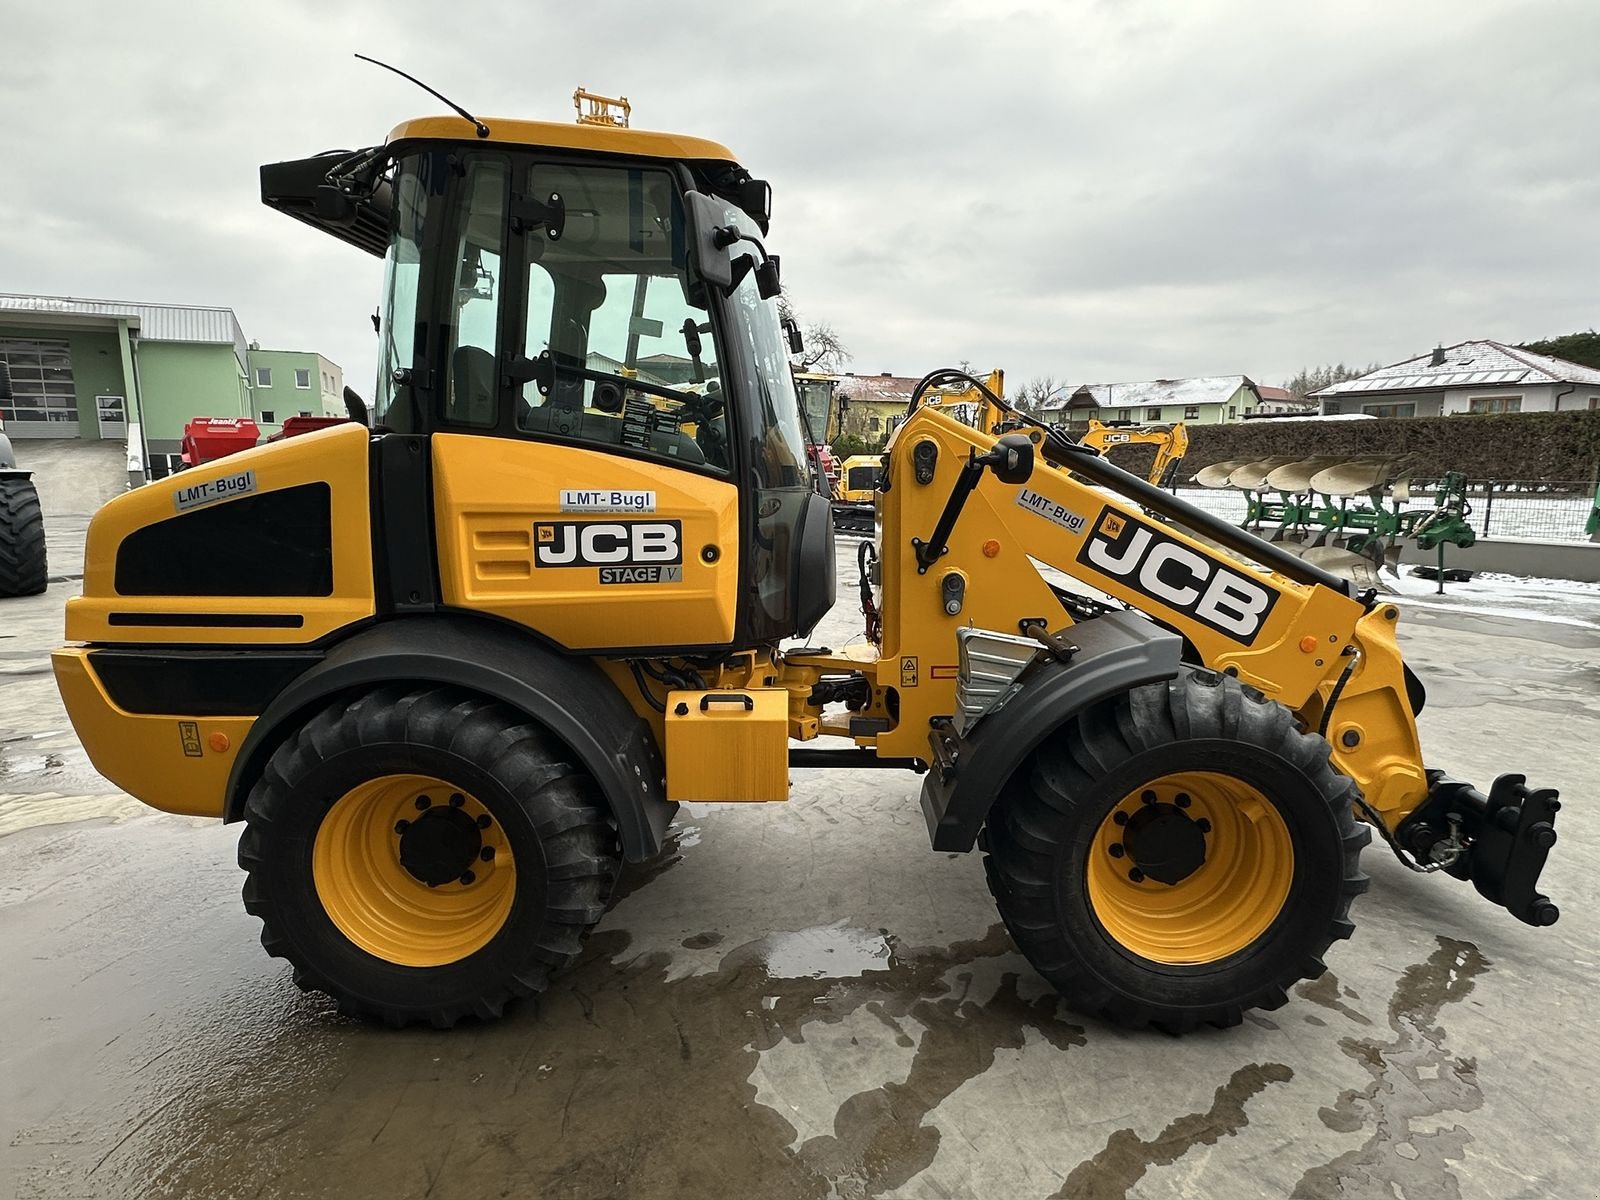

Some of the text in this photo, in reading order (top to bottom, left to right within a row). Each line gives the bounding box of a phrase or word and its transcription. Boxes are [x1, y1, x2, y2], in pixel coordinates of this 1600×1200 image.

[1103, 434, 1130, 443] JCB
[178, 471, 251, 503] LMT-Bugl
[1020, 489, 1085, 529] LMT-Bugl
[538, 523, 679, 564] JCB
[601, 567, 678, 583] STAGE V
[1088, 527, 1269, 636] JCB
